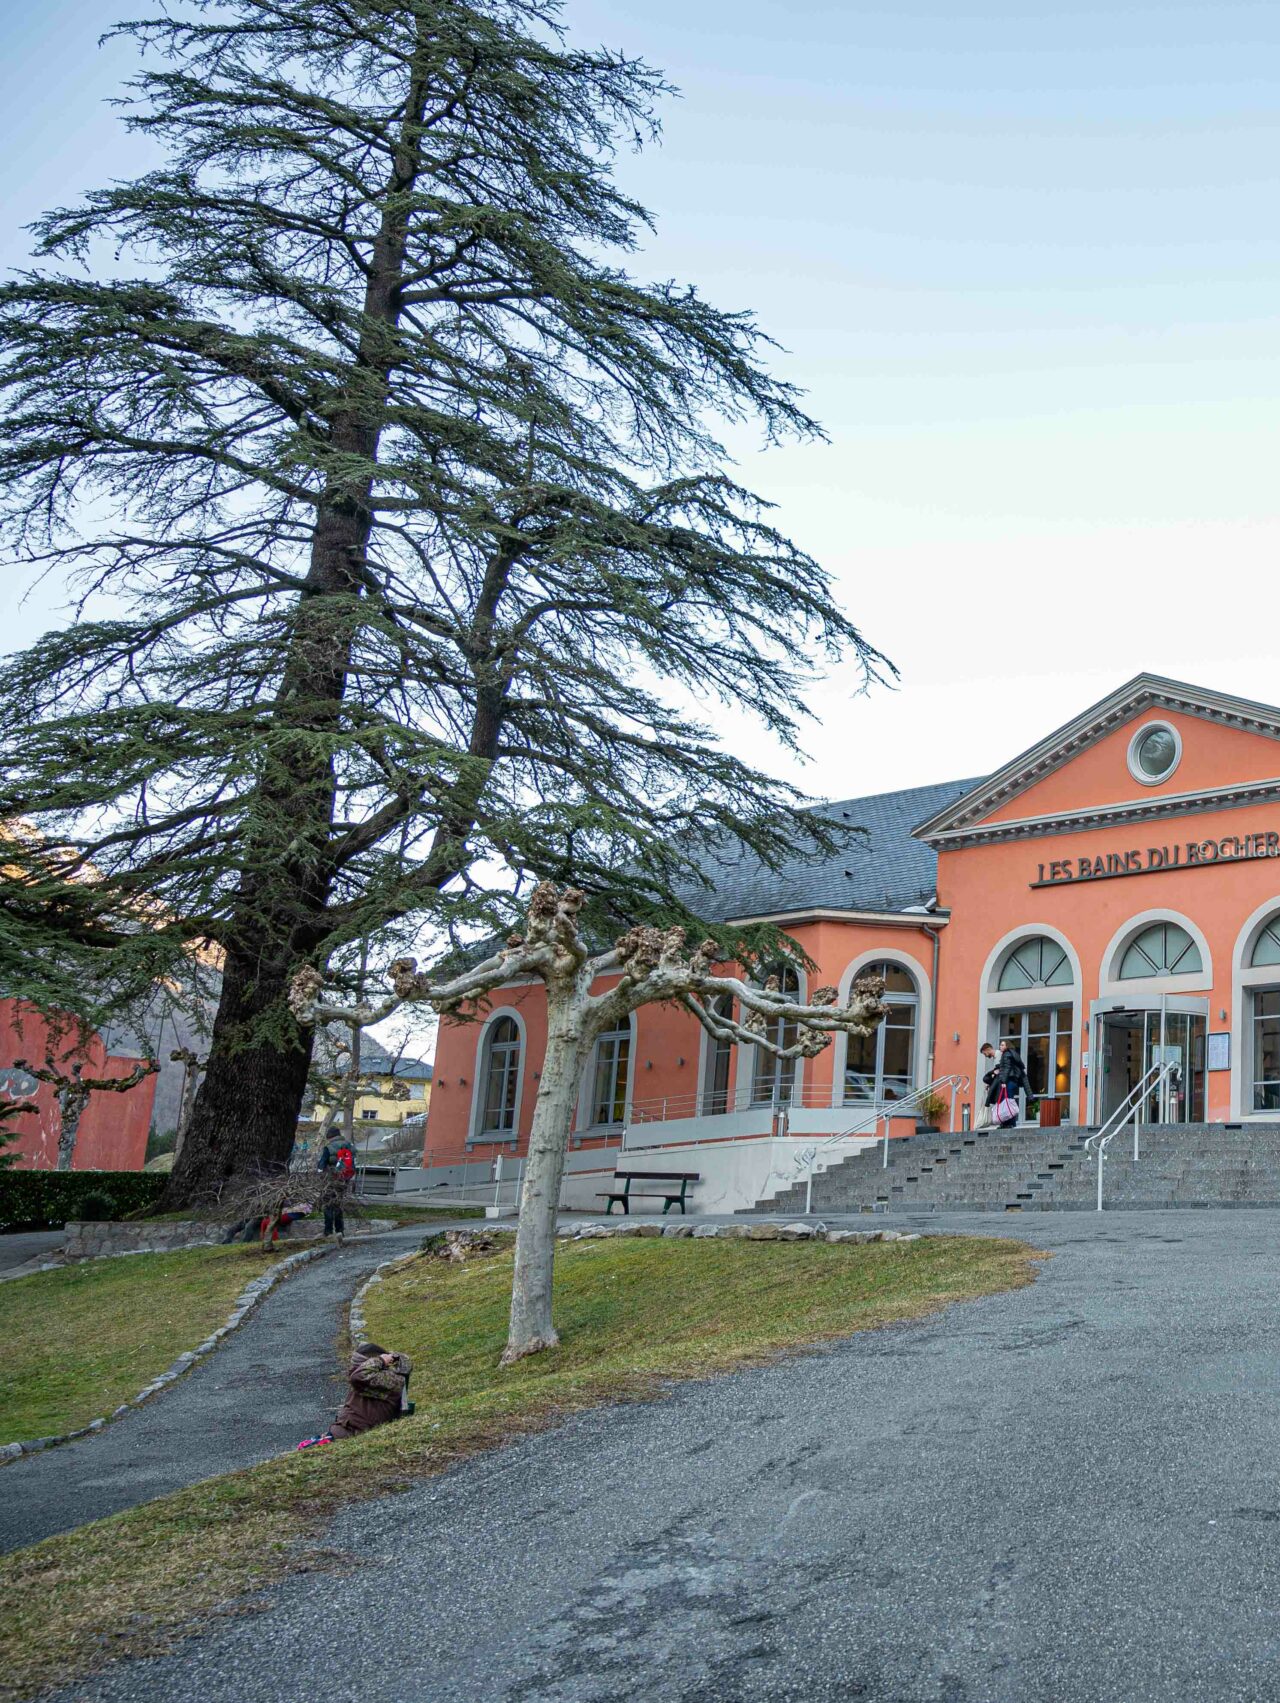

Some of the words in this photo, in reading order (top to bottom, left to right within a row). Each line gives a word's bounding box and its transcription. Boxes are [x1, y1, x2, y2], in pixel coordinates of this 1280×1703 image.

[1038, 860, 1073, 881] LES
[1078, 849, 1142, 878] BAINS
[1147, 845, 1180, 870] DU
[1186, 831, 1280, 864] ROCHER
